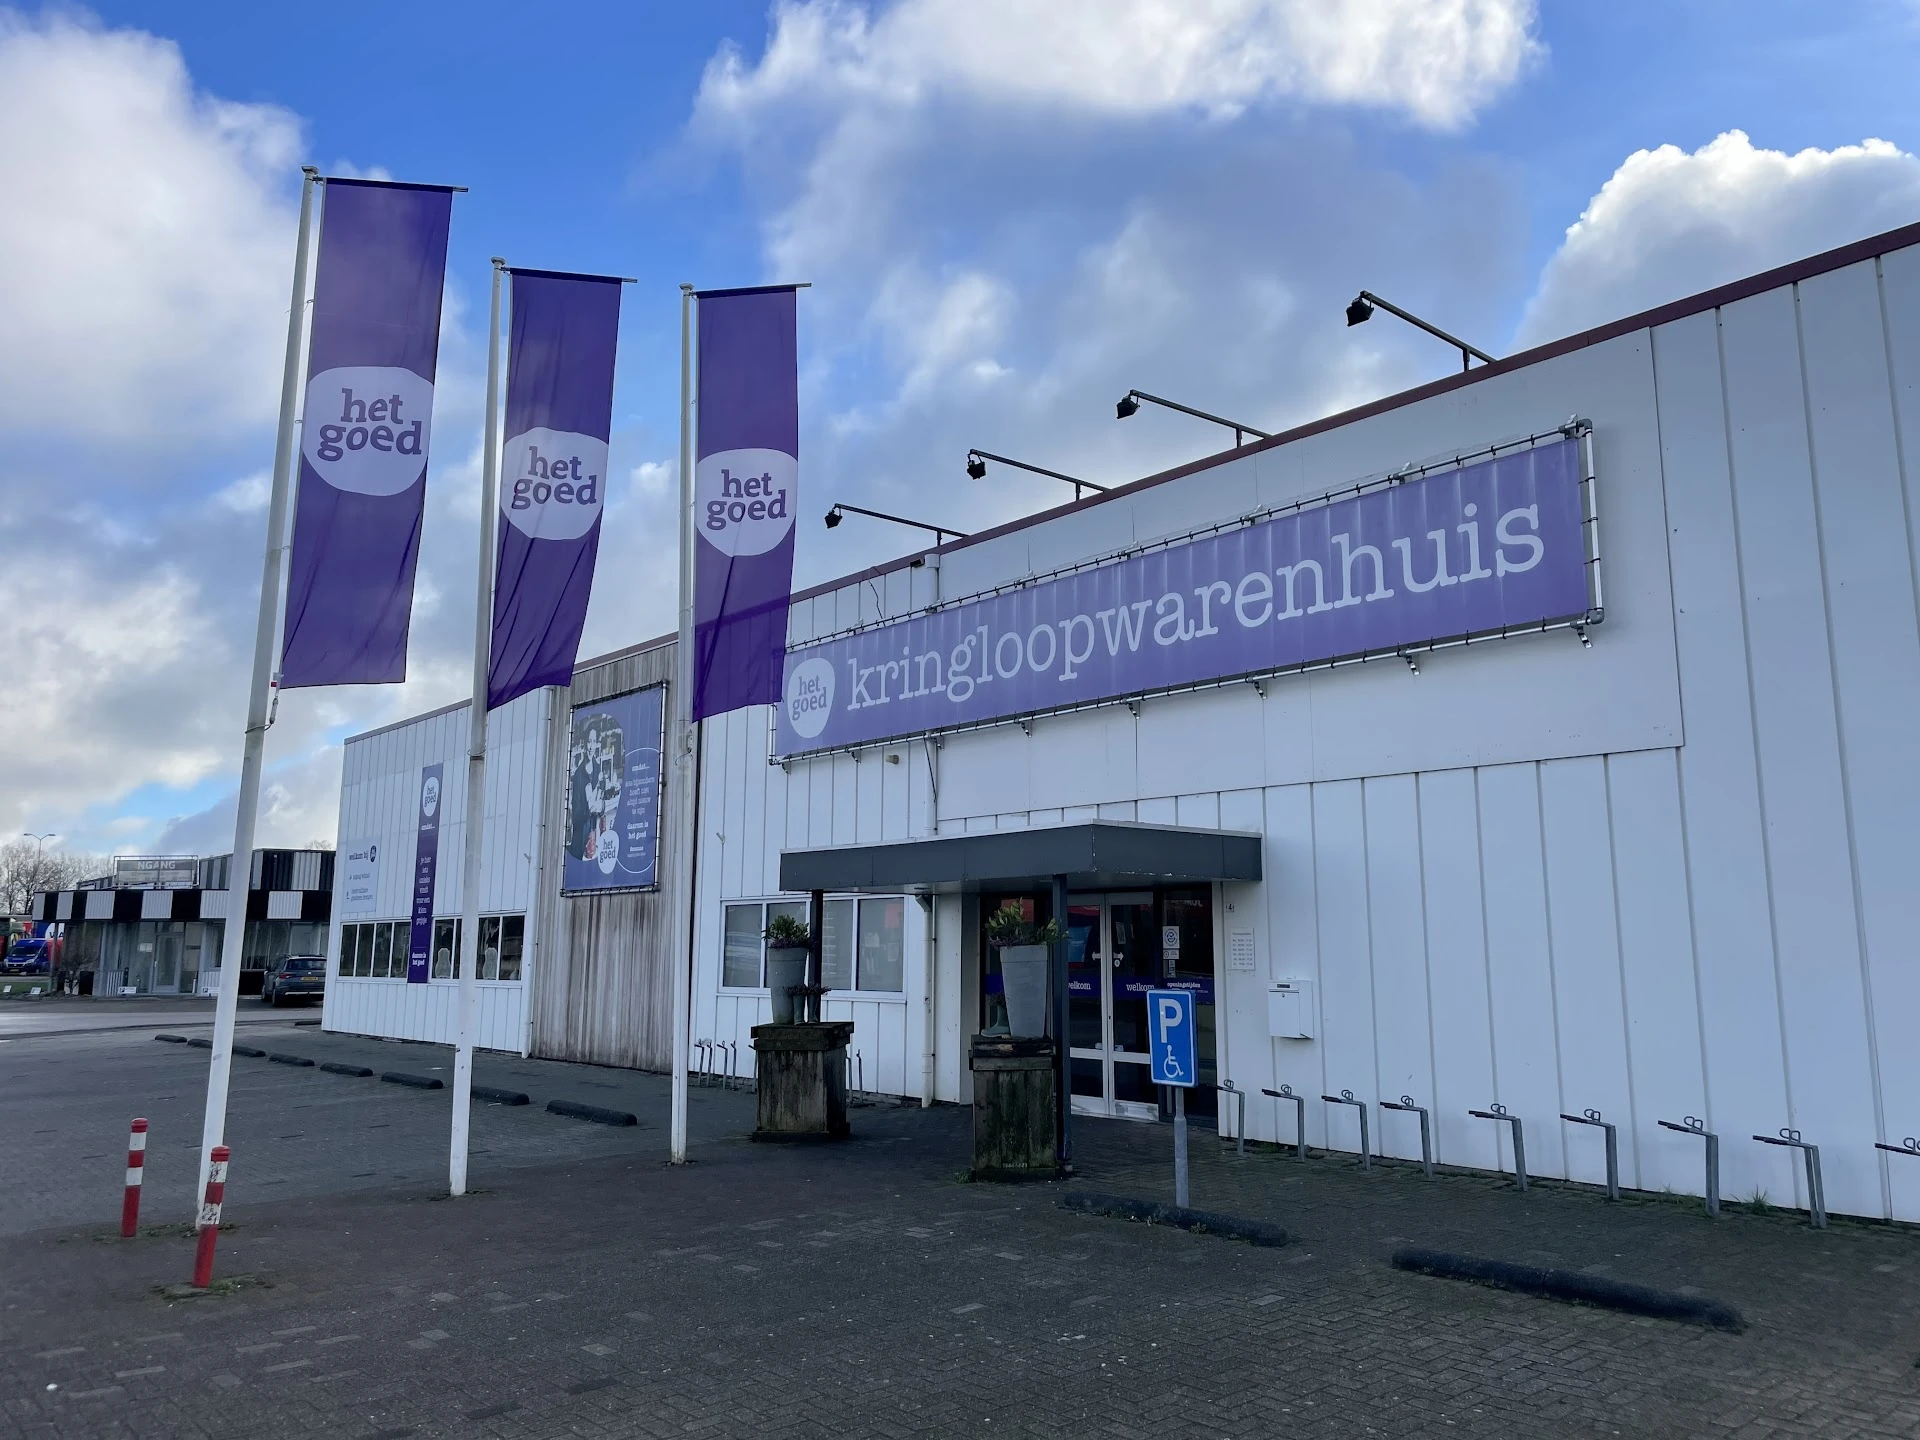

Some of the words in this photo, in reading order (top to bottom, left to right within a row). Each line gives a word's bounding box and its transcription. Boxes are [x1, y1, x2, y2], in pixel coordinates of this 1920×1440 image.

[340, 387, 404, 424] het
[317, 420, 423, 462] goed
[527, 446, 582, 481] het
[511, 475, 597, 511] goed
[721, 469, 773, 498] het
[705, 489, 787, 530] goed
[846, 502, 1545, 711] kringloopwarenhuis
[791, 687, 827, 720] goed
[798, 676, 820, 696] het
[600, 846, 616, 863] goed
[603, 838, 613, 851] het
[1159, 998, 1183, 1043] P
